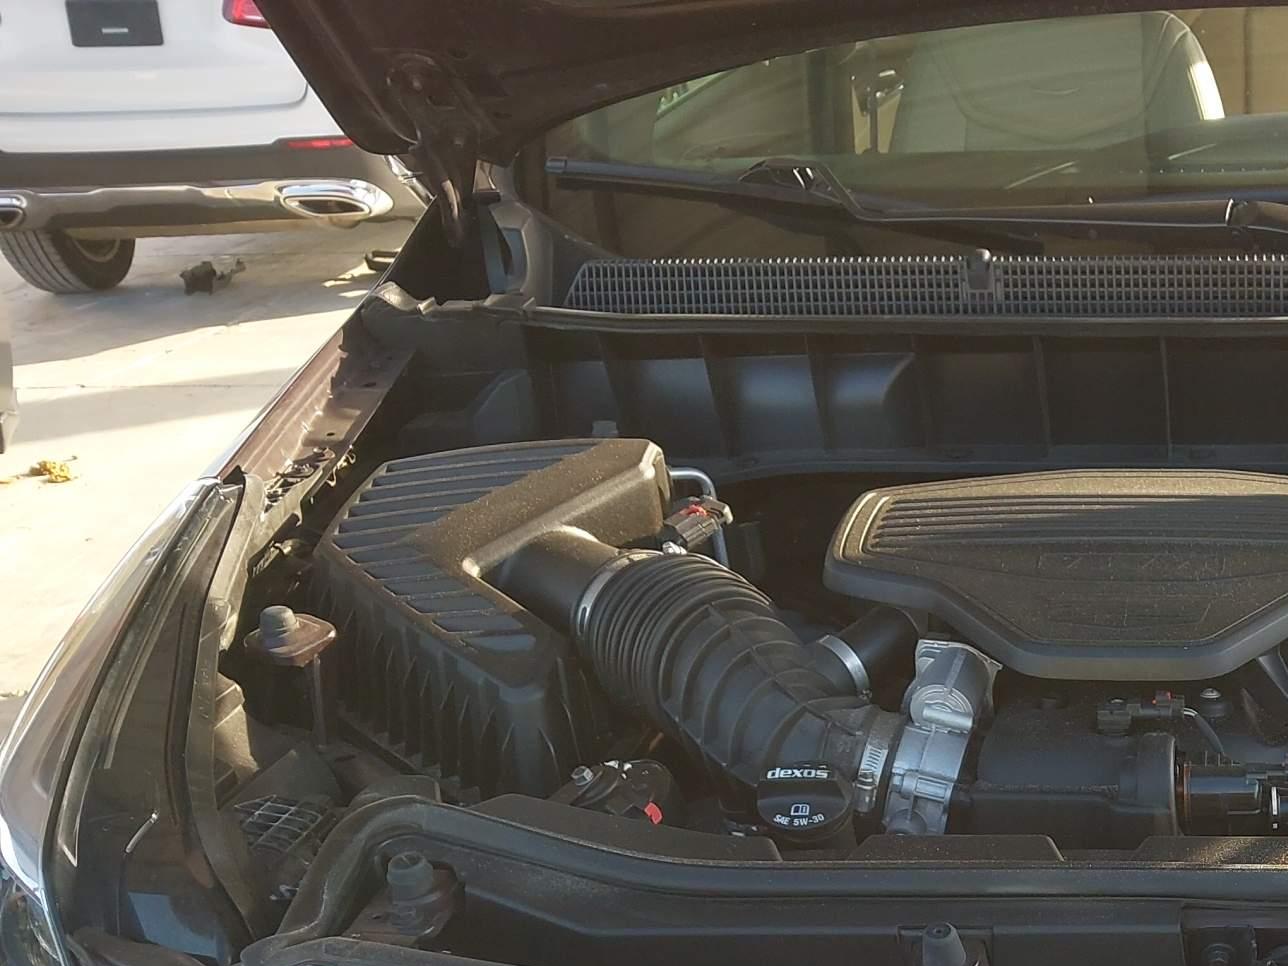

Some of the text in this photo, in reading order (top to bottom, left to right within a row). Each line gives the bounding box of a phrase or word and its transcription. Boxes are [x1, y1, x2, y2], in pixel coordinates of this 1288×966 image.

[766, 767, 829, 779] dexos
[773, 813, 825, 826] SAE 5W-30
